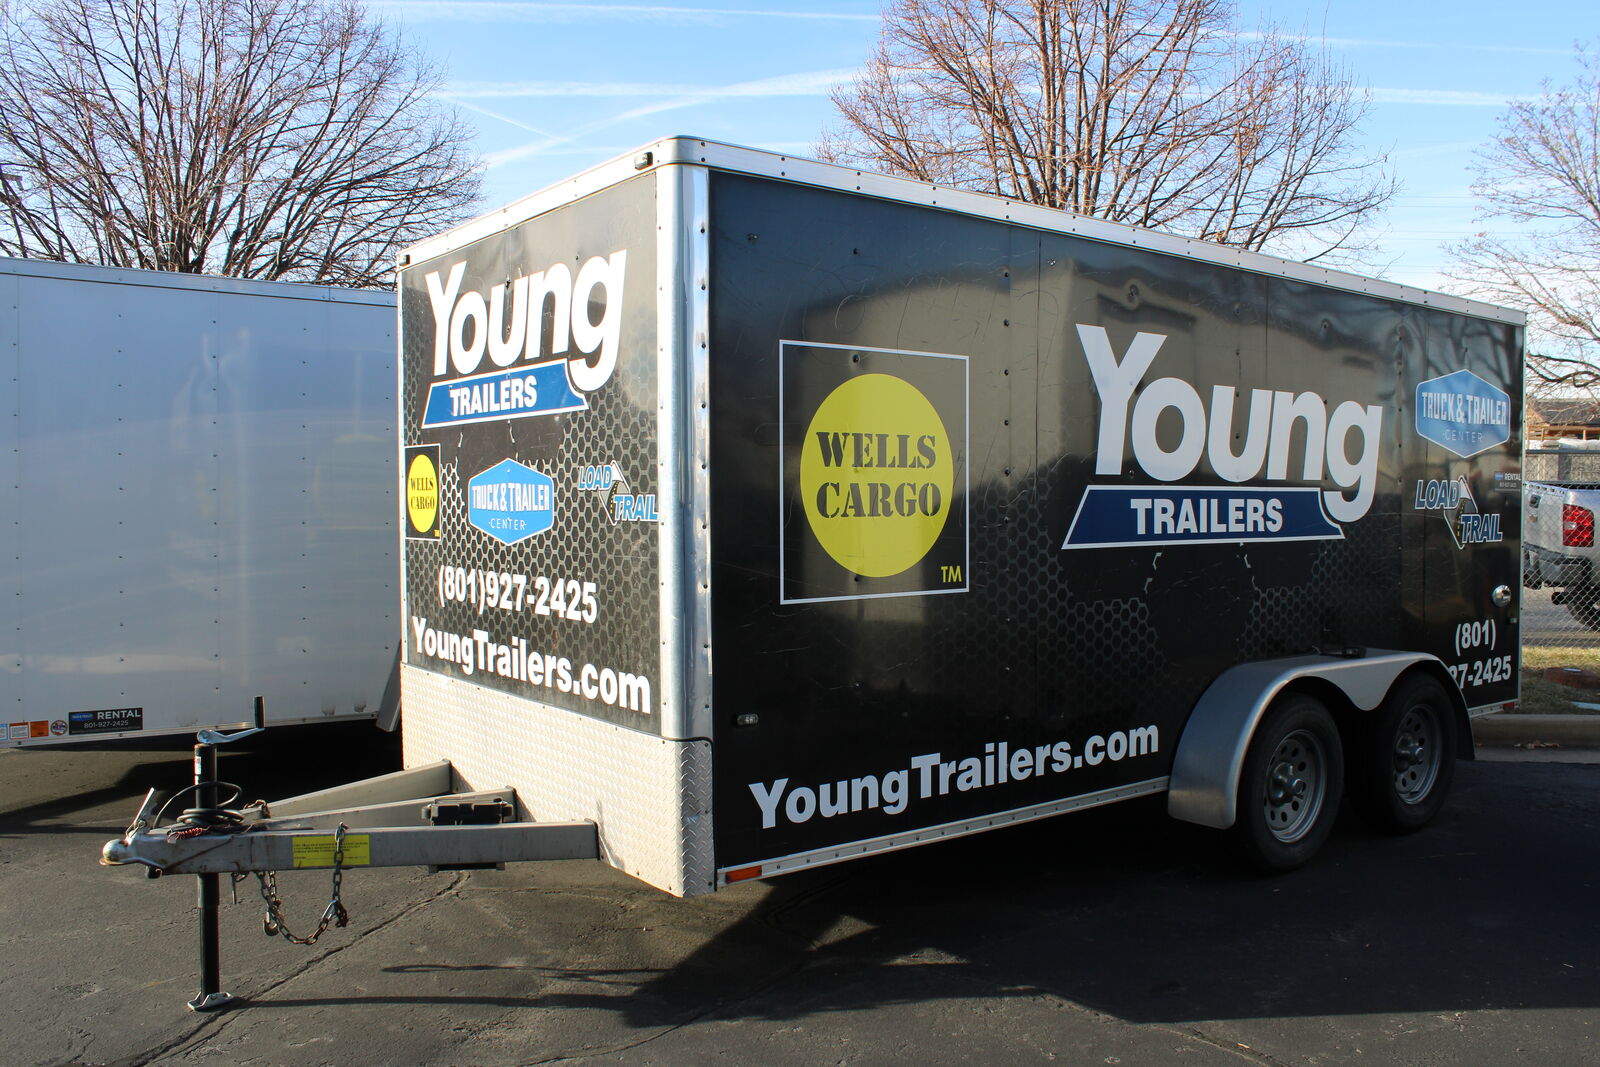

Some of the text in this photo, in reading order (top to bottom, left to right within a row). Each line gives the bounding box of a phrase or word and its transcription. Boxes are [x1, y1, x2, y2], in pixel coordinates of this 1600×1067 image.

[424, 248, 627, 392] Young
[449, 374, 538, 417] TRAILERS
[1075, 323, 1383, 522] Young
[1444, 429, 1482, 443] CENTER
[816, 431, 936, 469] WELLS
[410, 477, 434, 491] WELLS
[577, 464, 612, 491] LOAD
[410, 495, 435, 510] CARGO
[613, 494, 660, 522] TRAIL
[816, 482, 942, 518] CARGO
[1415, 480, 1460, 510] LOAD
[490, 518, 526, 531] CENTER
[1130, 498, 1283, 534] TRAILERS
[1461, 513, 1503, 544] TRAIL
[941, 565, 962, 583] TM
[1455, 618, 1496, 657] (801)
[412, 615, 651, 715] YoungTrailers.com
[97, 709, 141, 720] RENTAL
[748, 724, 1159, 829] YoungTrailers.com
